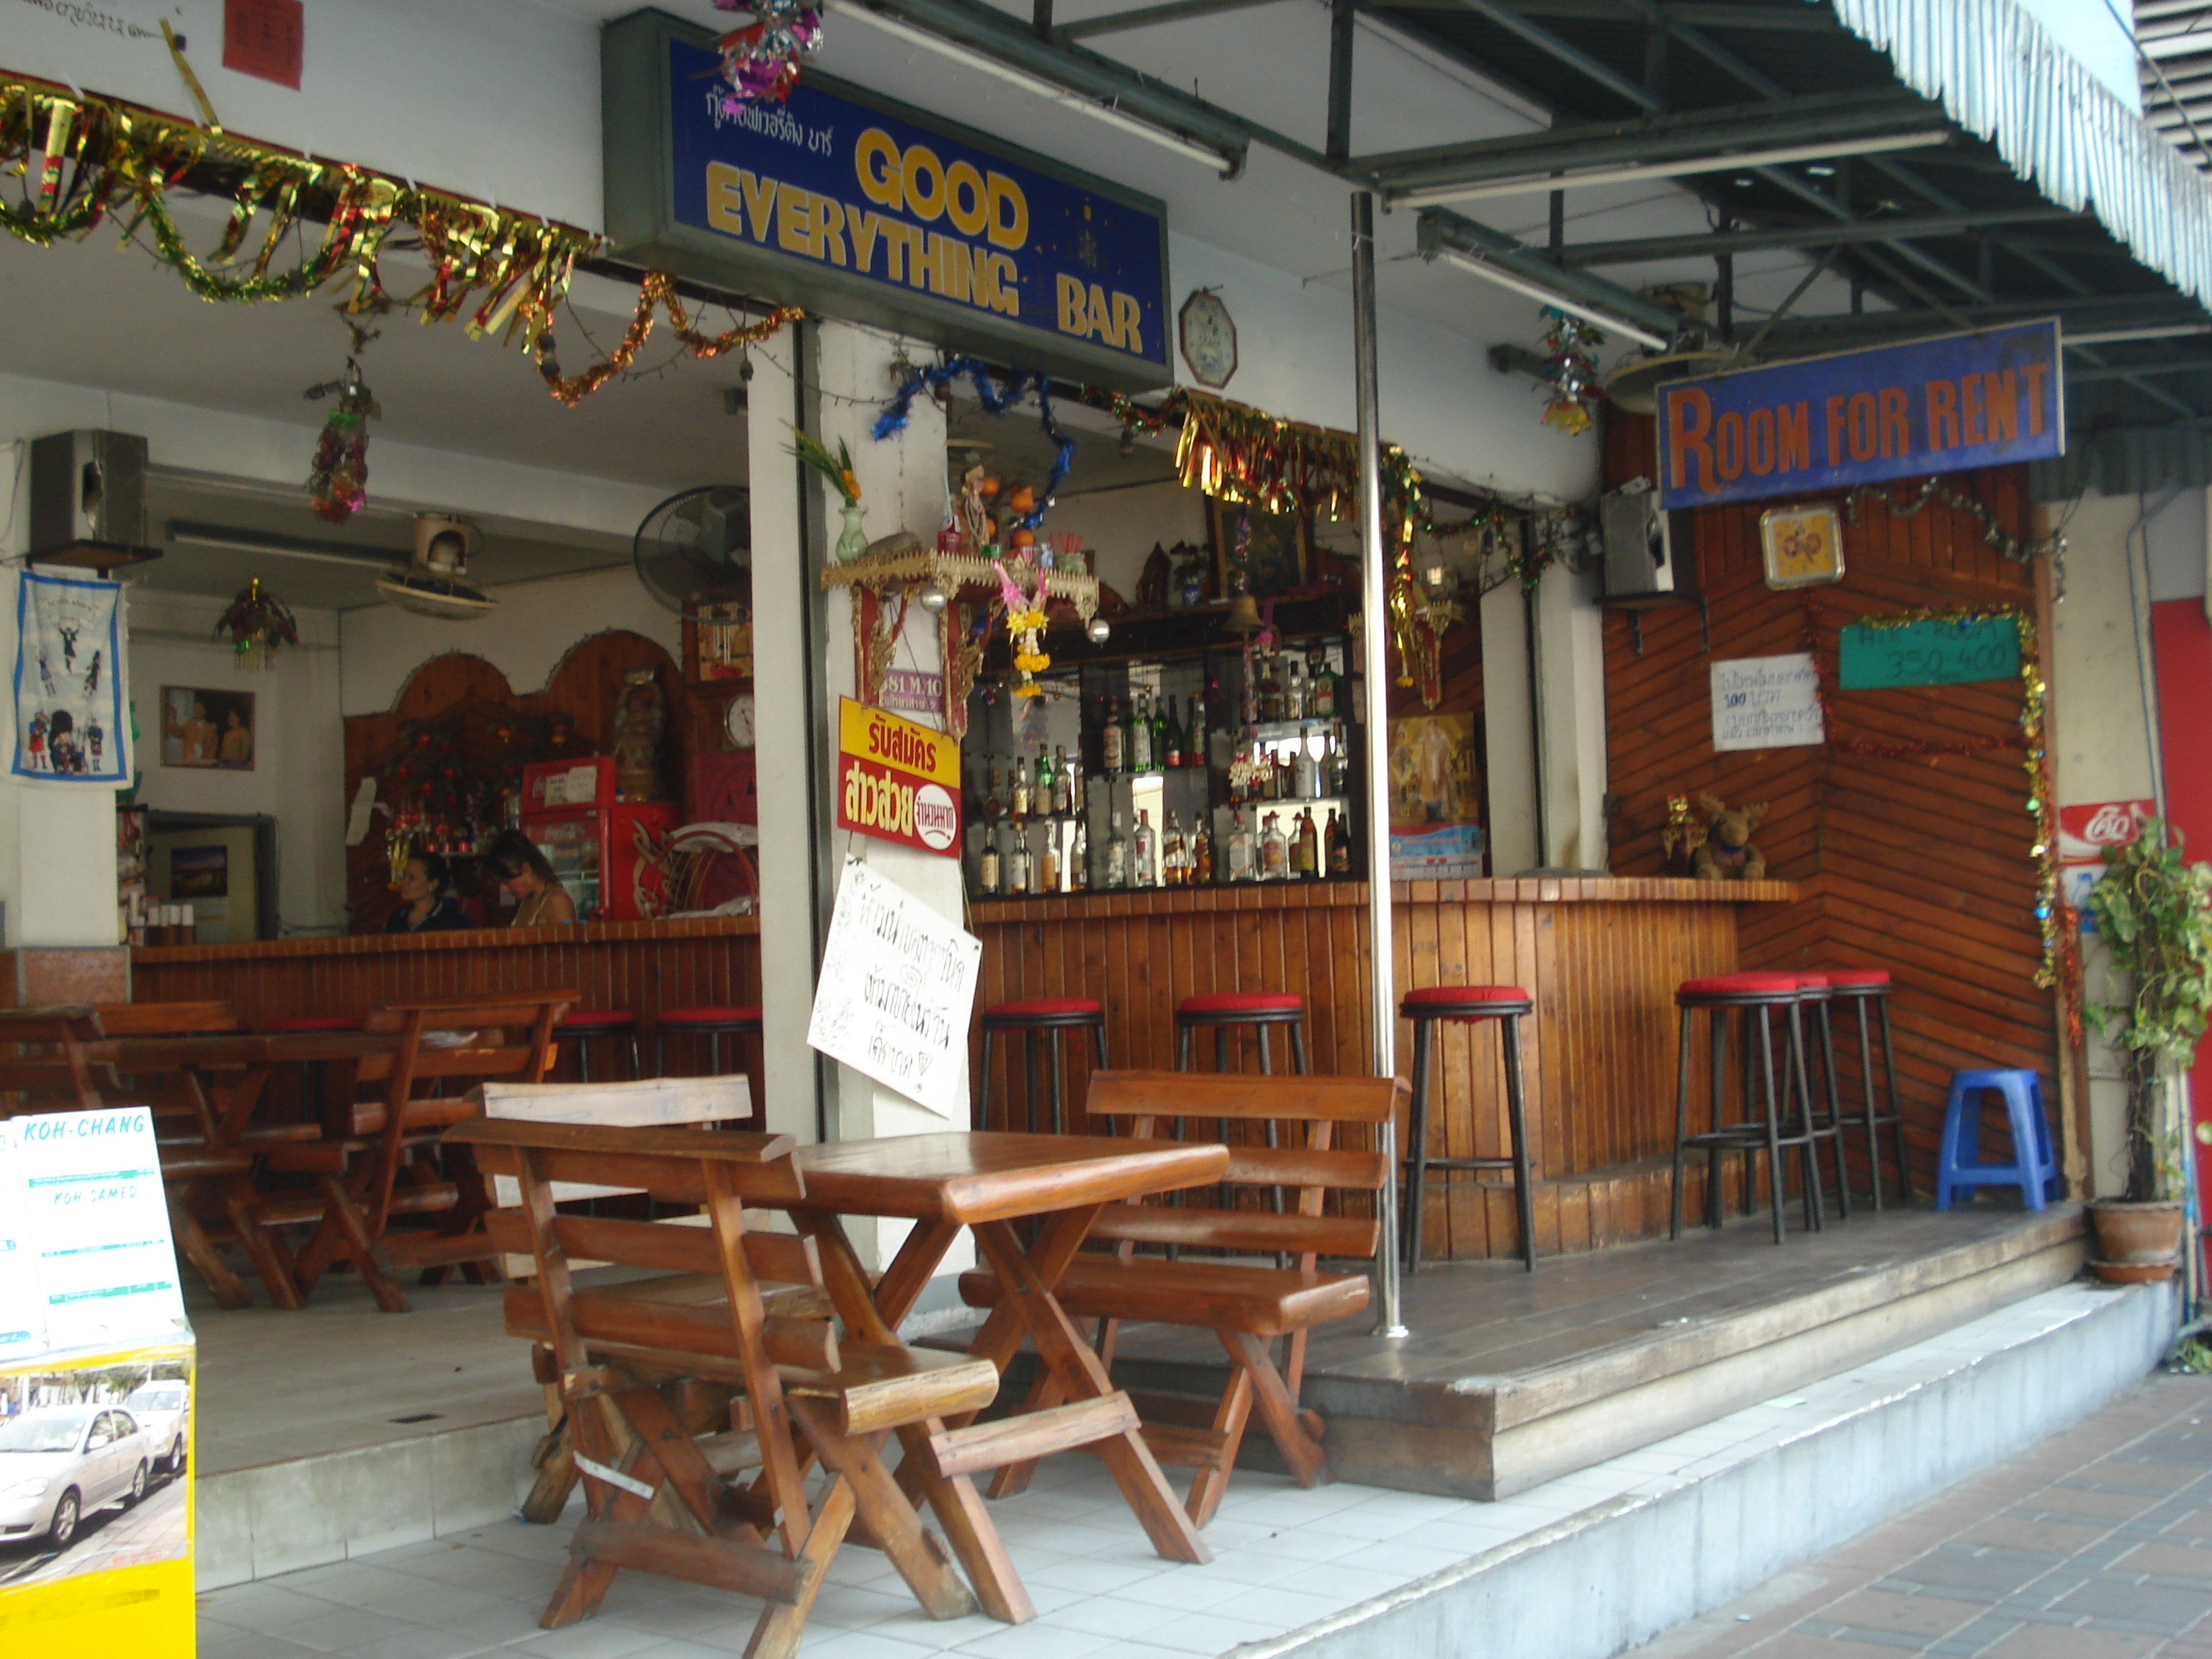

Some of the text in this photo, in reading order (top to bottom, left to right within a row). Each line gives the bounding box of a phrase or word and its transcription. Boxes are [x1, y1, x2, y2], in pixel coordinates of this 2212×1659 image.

[855, 128, 1029, 251] GOOD
[706, 160, 1143, 354] EVERYTHING BAR
[1668, 362, 2048, 495] ROOM FOR RENT
[868, 713, 937, 773] รับสมัคร
[845, 760, 914, 837] สาวสวย
[24, 1114, 145, 1141] KOH-CHANG
